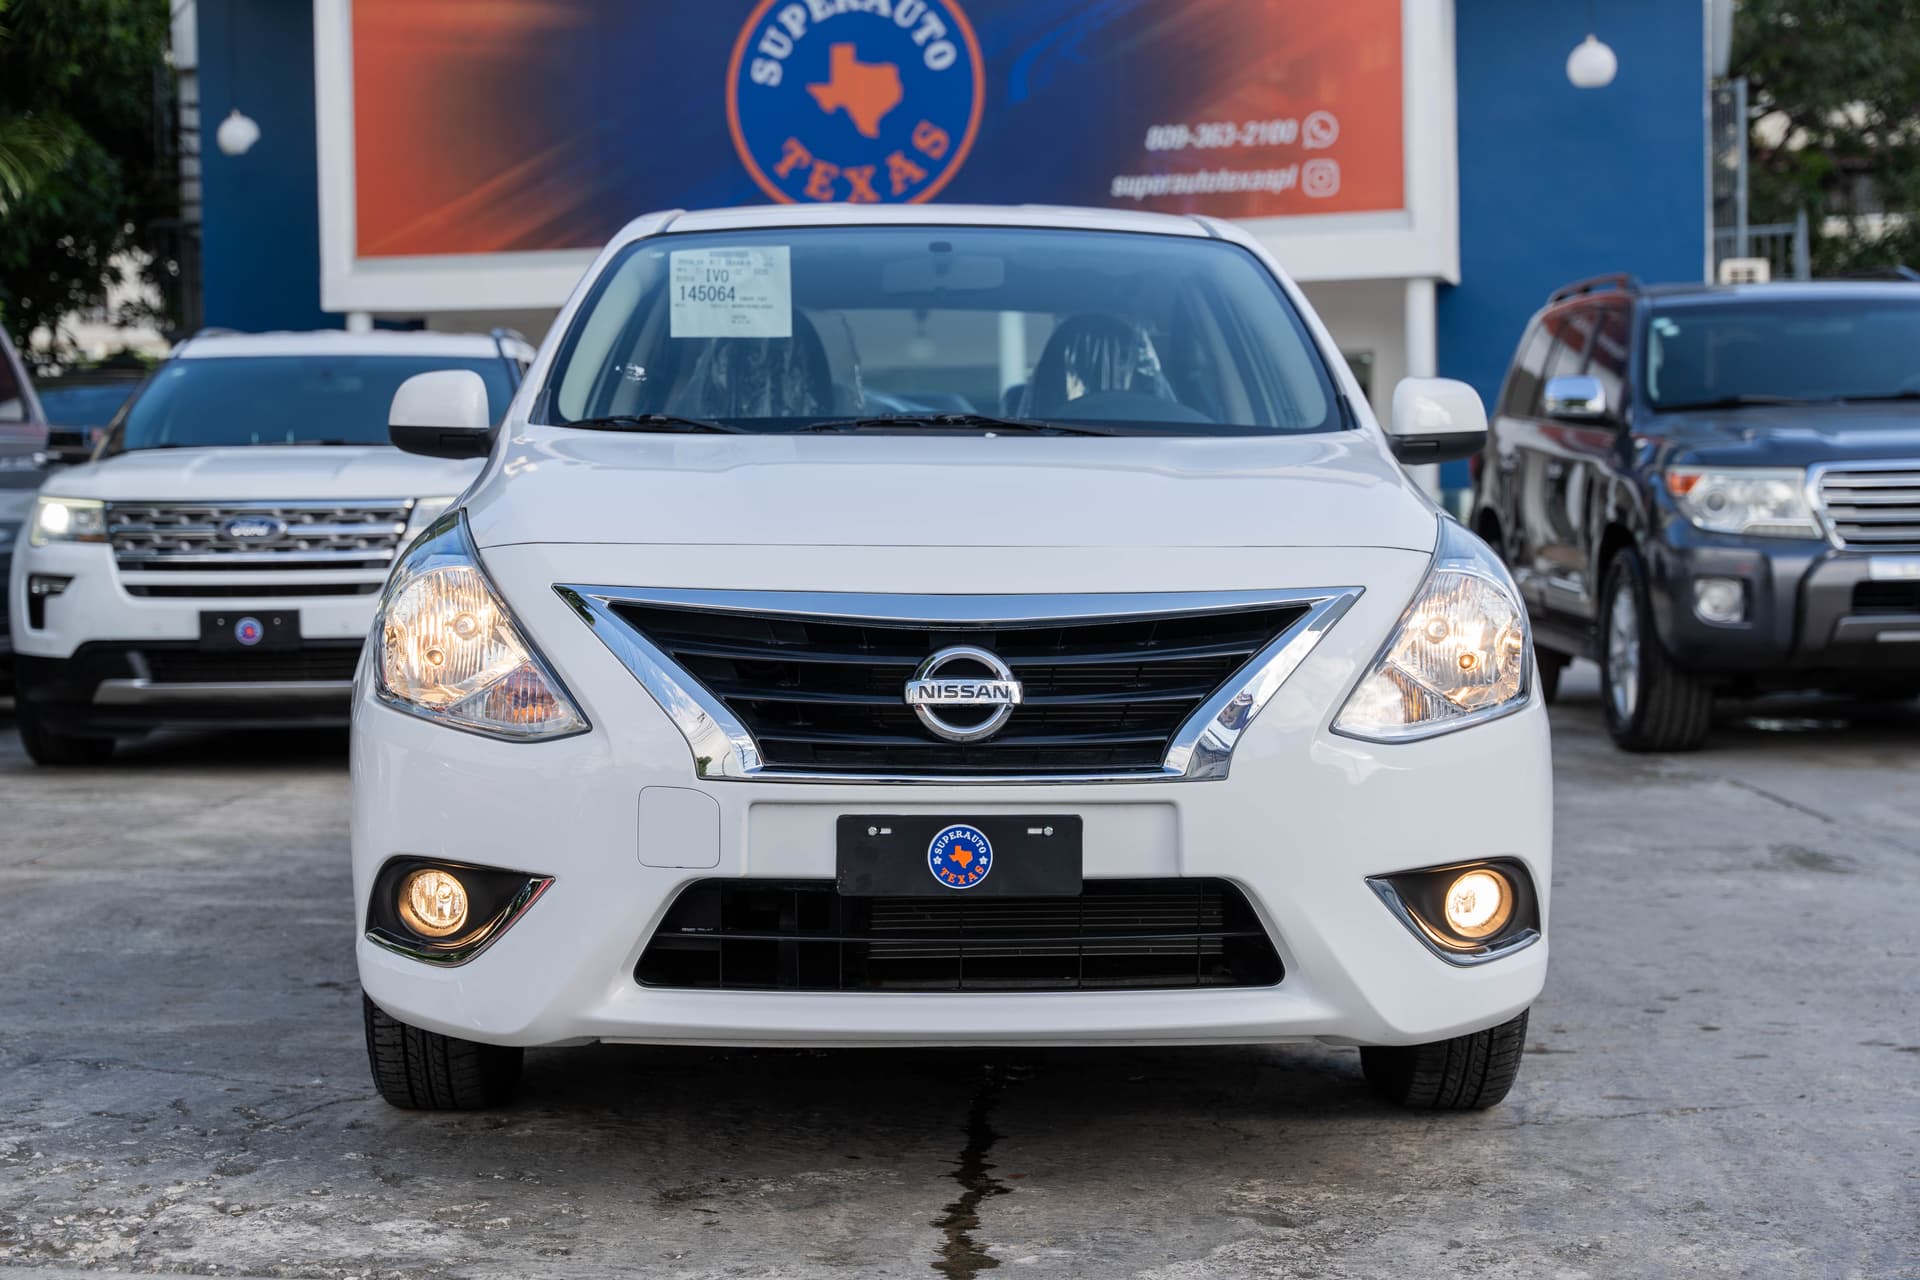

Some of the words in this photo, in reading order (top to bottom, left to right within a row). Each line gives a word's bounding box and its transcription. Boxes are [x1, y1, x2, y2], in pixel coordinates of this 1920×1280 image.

[773, 119, 950, 203] TEXAS
[679, 285, 736, 302] 145064
[918, 685, 1009, 699] NISSAN
[934, 830, 987, 855] SUPERAUTO
[939, 866, 985, 885] TEXAS
